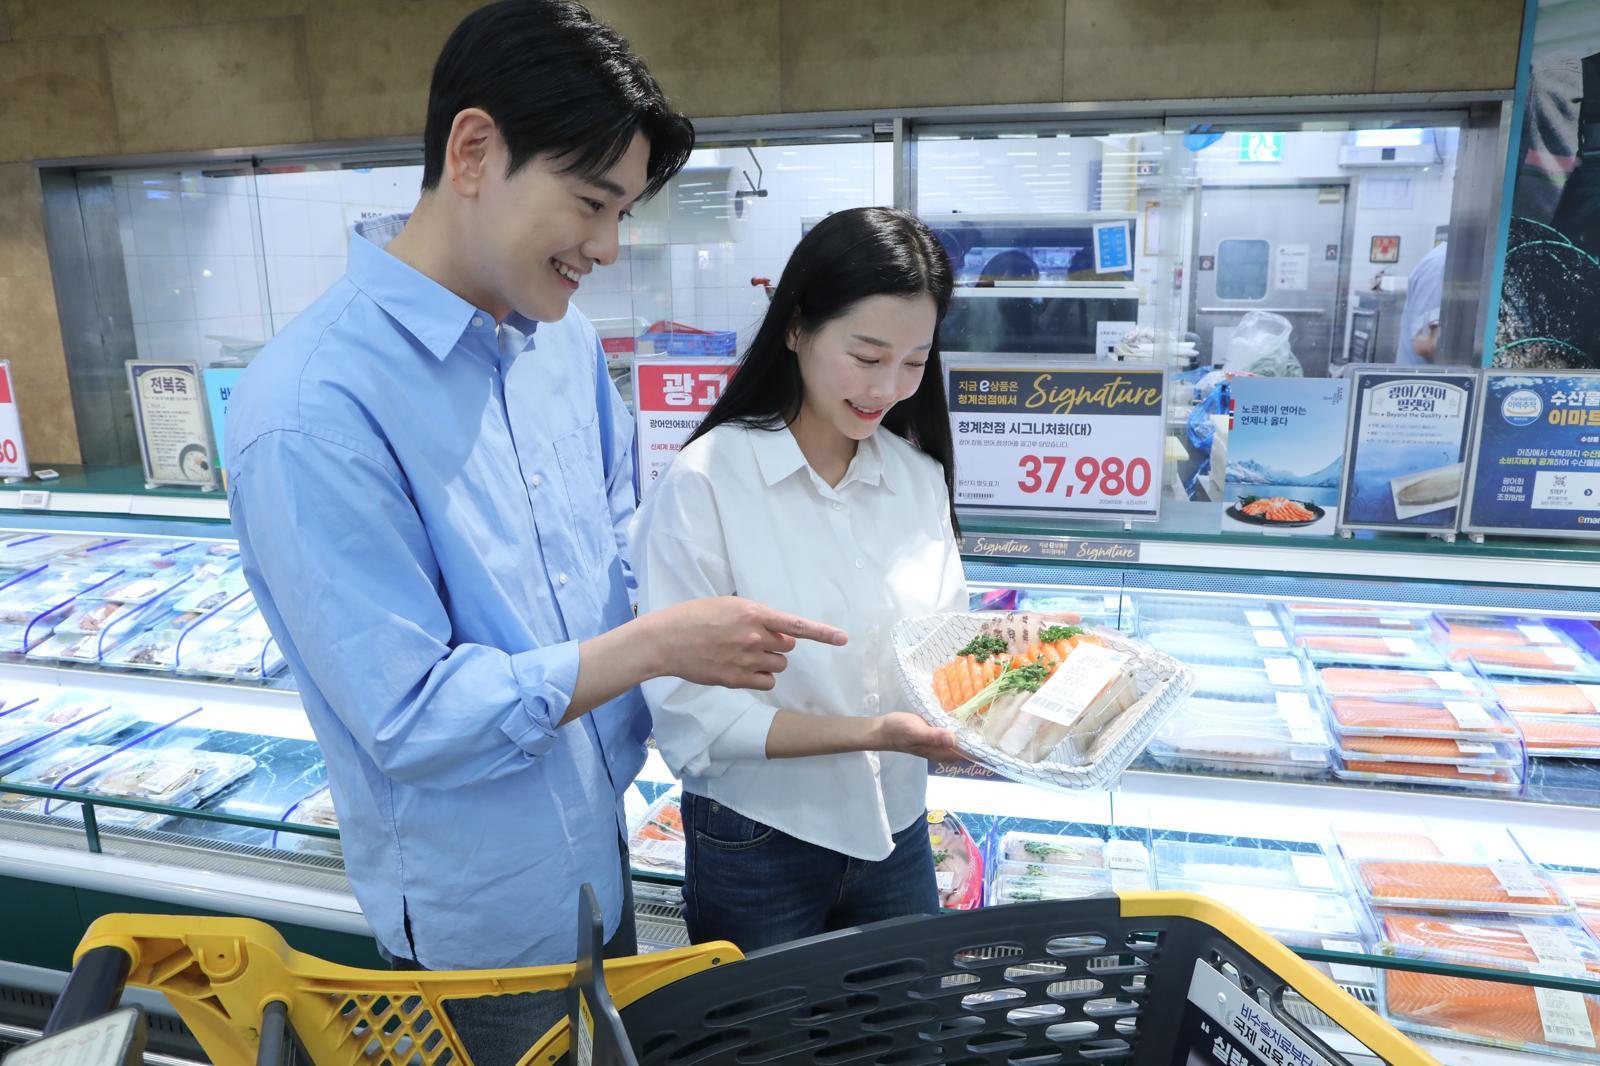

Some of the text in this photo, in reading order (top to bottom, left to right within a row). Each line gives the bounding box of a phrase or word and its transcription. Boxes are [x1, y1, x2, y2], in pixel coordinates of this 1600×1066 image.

[151, 376, 186, 394] 전복죽
[959, 380, 977, 391] 지금
[958, 394, 1017, 406] 청계천점에서
[1025, 374, 1161, 414] Signature
[1389, 385, 1447, 401] 광어/연어
[1550, 390, 1600, 407] 수산물
[1242, 404, 1307, 415] 노르웨이 연어는
[1397, 399, 1436, 412] 필렛회
[958, 421, 1092, 436] 청계천점 시그니처회(대)
[1241, 415, 1289, 427] 언제나 옳다
[1516, 448, 1548, 458] 어장에서
[1549, 449, 1580, 458] 식탁까지
[1498, 457, 1537, 466] 소비자에게
[1538, 457, 1569, 466] 공개하여
[1018, 454, 1151, 497] 37,980
[1500, 485, 1523, 493] 이력제
[1496, 493, 1525, 501] 조회방법
[973, 537, 1031, 556] Signature
[1076, 542, 1135, 560] Signature
[1233, 1015, 1284, 1066] 국제 교육
[1240, 1003, 1314, 1066] 비수술치료부터
